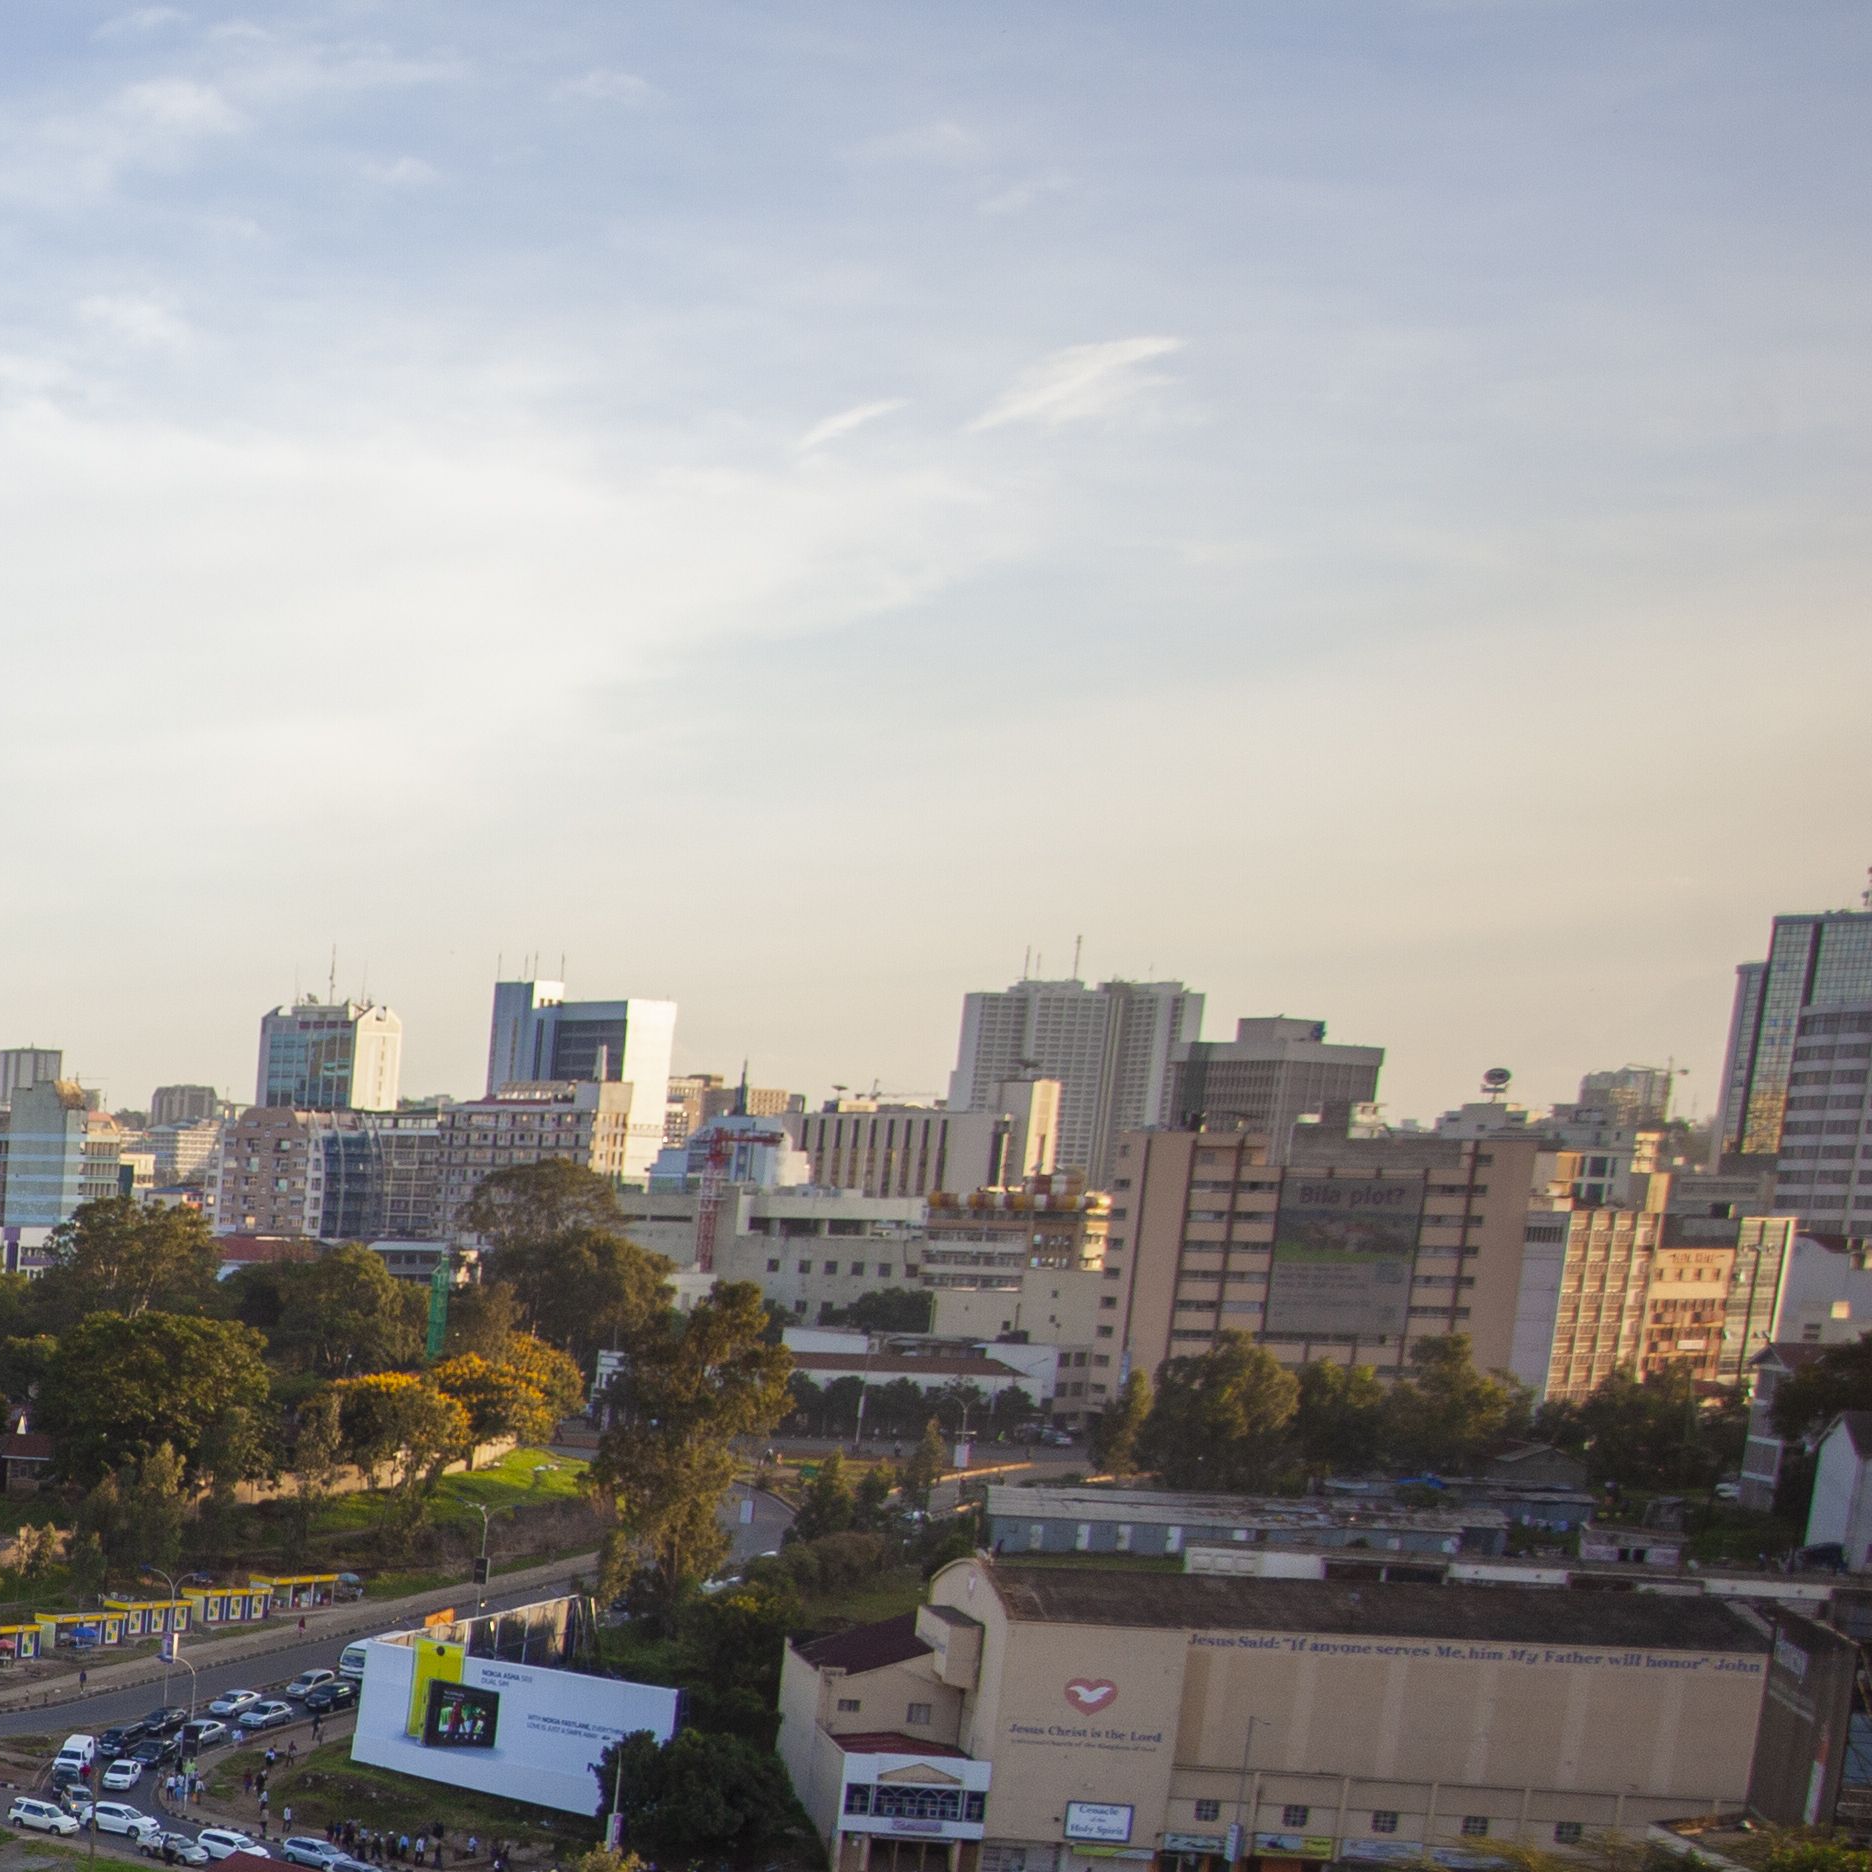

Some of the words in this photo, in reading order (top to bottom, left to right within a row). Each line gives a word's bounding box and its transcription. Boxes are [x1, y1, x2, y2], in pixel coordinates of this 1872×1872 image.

[1187, 1633, 1234, 1647] Jesus
[1310, 1641, 1371, 1655] anyone
[1376, 1646, 1429, 1657] serves
[1469, 1647, 1503, 1661] him
[1508, 1649, 1538, 1665] My
[1544, 1651, 1602, 1665] Father
[1608, 1652, 1640, 1666] will
[1714, 1658, 1760, 1673] John
[482, 1669, 503, 1679] NOKIA
[504, 1671, 520, 1681] ASHA
[1009, 1724, 1045, 1734] Jesus
[1048, 1725, 1088, 1737] Christ
[1090, 1728, 1101, 1738] is
[1105, 1729, 1126, 1741] the
[1130, 1731, 1163, 1743] Lord
[1079, 1805, 1120, 1816] Cenacle
[1070, 1824, 1094, 1834] Holy
[1096, 1825, 1124, 1836] Spirit
